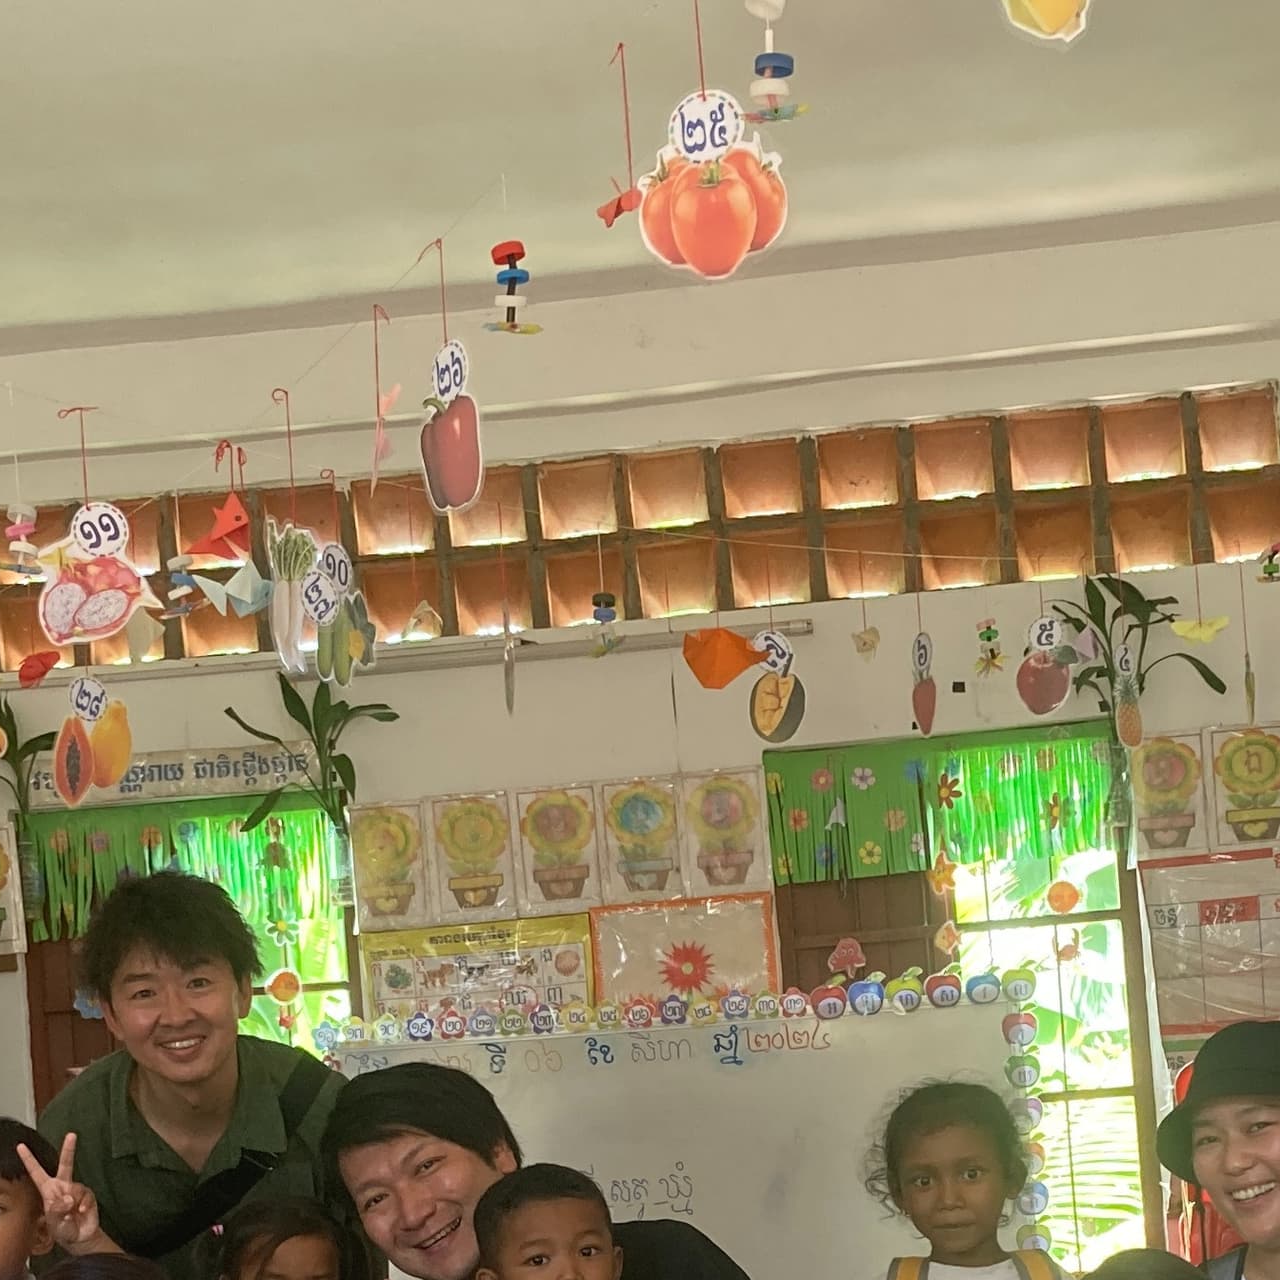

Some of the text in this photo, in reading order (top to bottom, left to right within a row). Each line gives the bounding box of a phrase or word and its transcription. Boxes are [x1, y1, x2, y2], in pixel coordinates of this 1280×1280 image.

[680, 103, 726, 155] ២៥
[79, 512, 122, 550] ១១
[325, 552, 348, 586] ១០
[411, 1022, 429, 1036] ១៩
[444, 1021, 462, 1034] ២០
[474, 1017, 492, 1031] ២១
[757, 999, 776, 1012] ៣០
[785, 998, 804, 1011] ៣១
[523, 1040, 564, 1075] ០៦
[585, 1037, 616, 1065] ខែ
[630, 1033, 693, 1063] សីហា
[742, 1022, 832, 1053] ២០២៤
